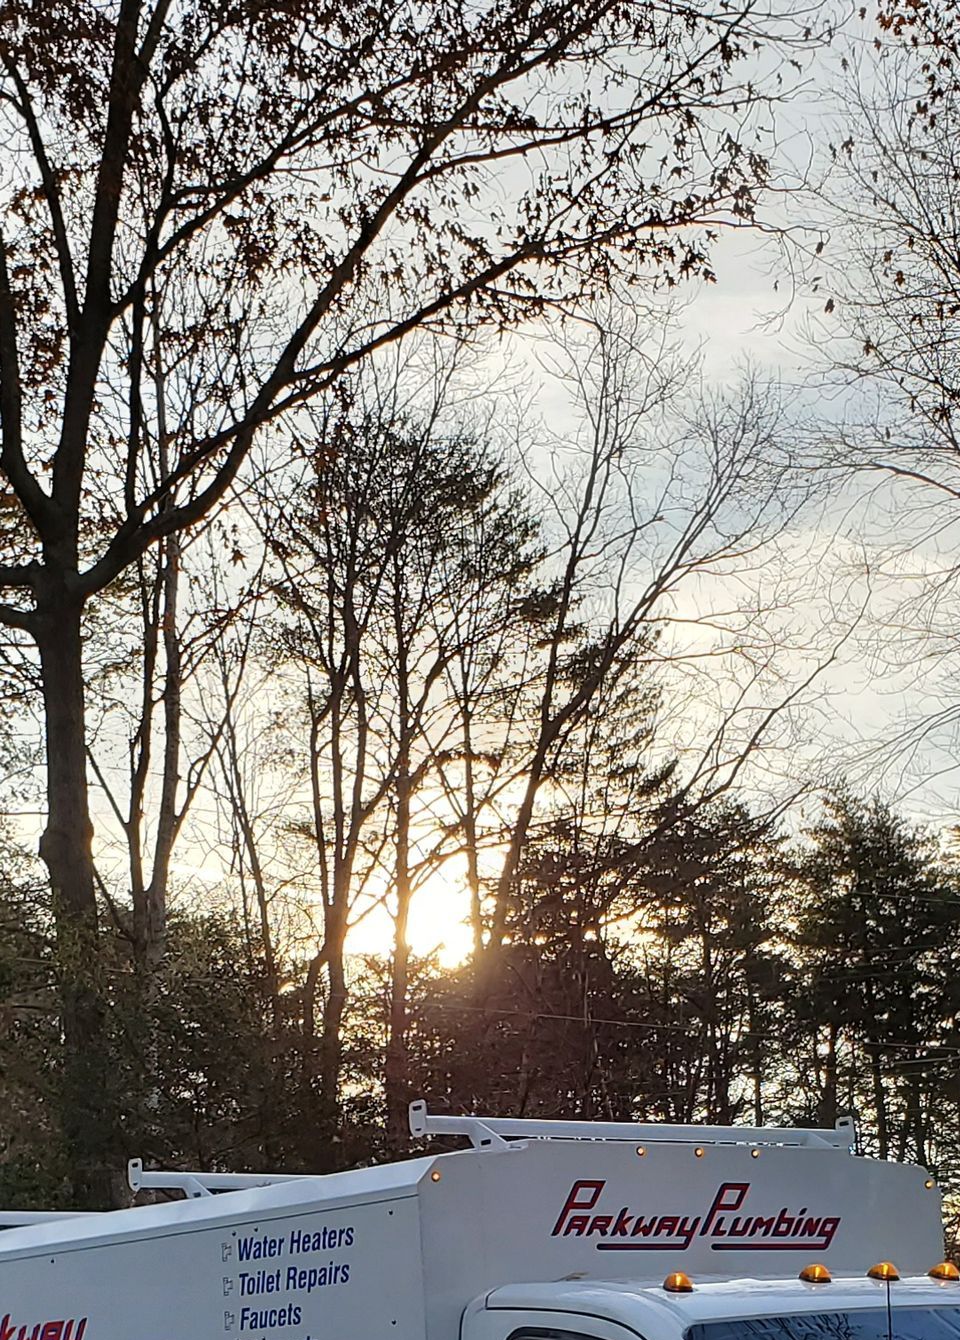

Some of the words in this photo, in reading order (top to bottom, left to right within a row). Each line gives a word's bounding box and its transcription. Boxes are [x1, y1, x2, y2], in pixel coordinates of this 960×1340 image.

[238, 1235, 285, 1262] Water
[289, 1226, 355, 1255] Heaters
[239, 1269, 281, 1296] Toilet
[285, 1261, 350, 1293] Repairs
[240, 1303, 302, 1331] Faucets
